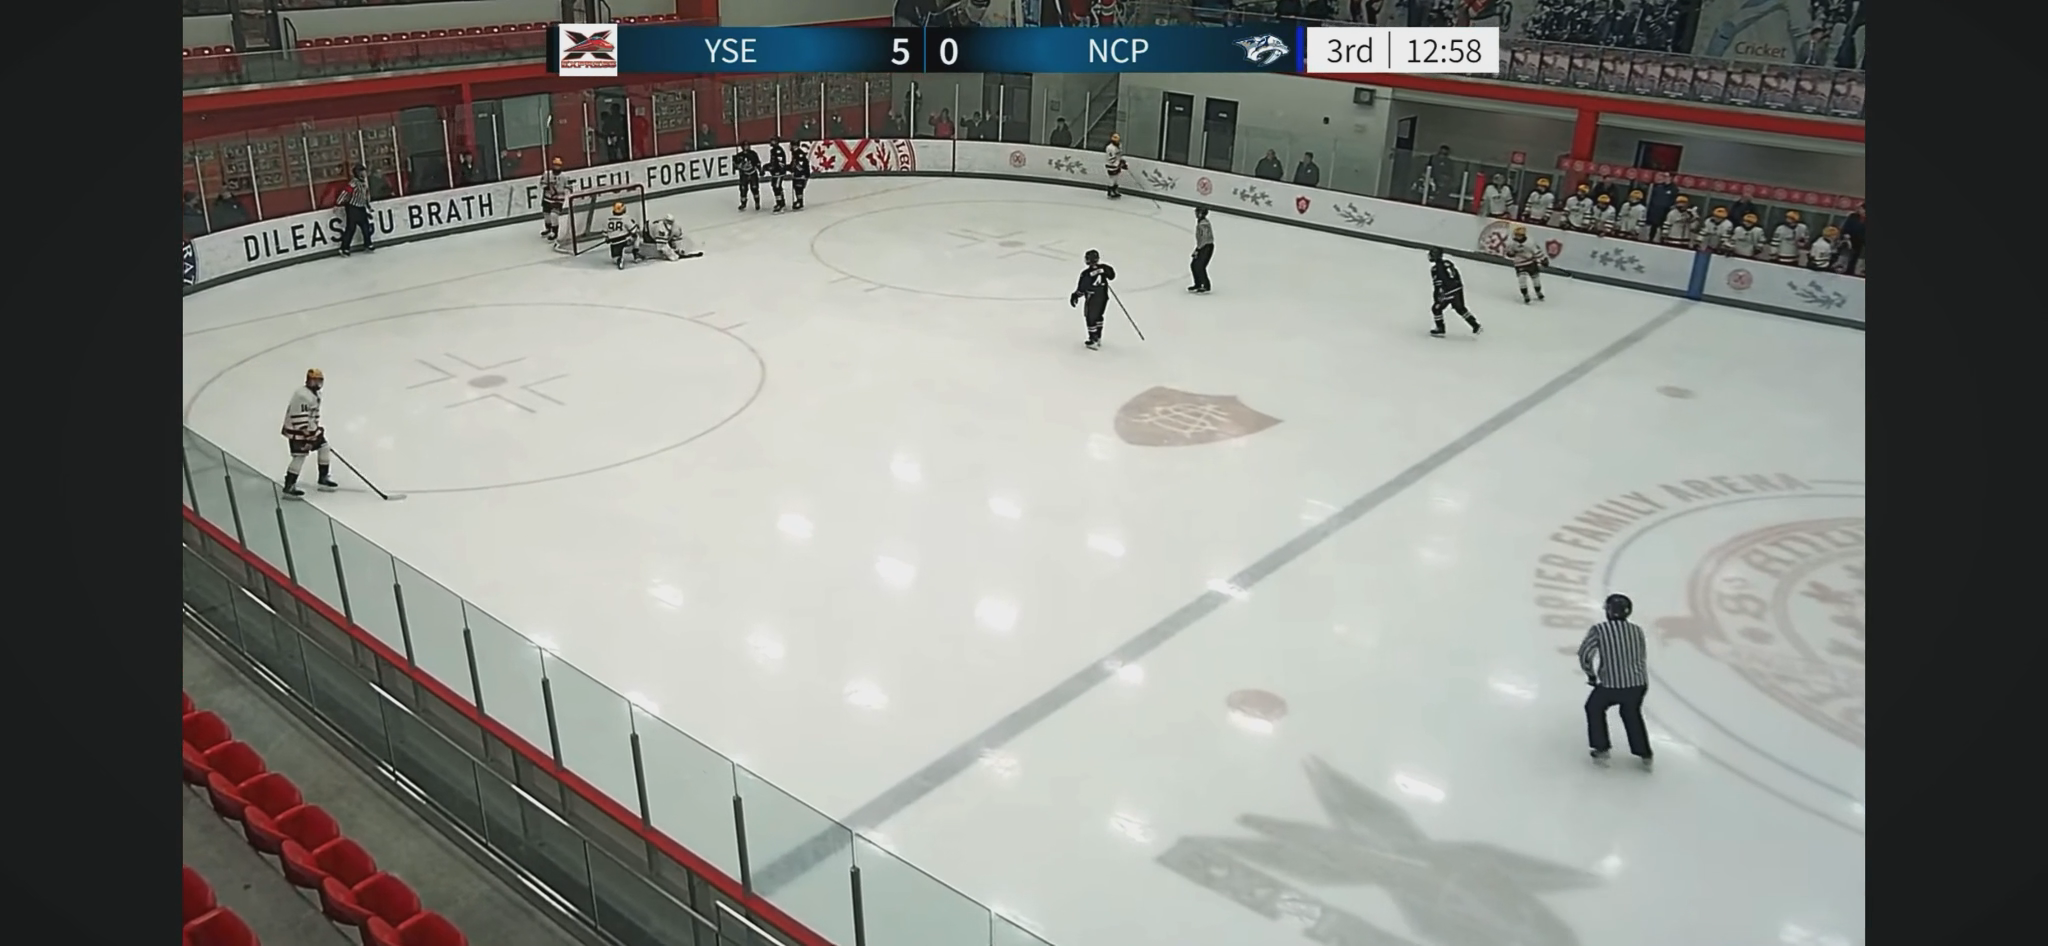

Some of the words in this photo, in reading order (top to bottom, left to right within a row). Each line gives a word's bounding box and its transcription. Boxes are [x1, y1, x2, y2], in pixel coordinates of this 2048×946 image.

[1734, 41, 1788, 59] Cricket
[243, 217, 345, 263] DILEAS
[408, 193, 494, 230] BRATH
[646, 155, 738, 189] FOREVE
[1548, 490, 1669, 553] FAMILY
[1657, 472, 1815, 502] ARENA
